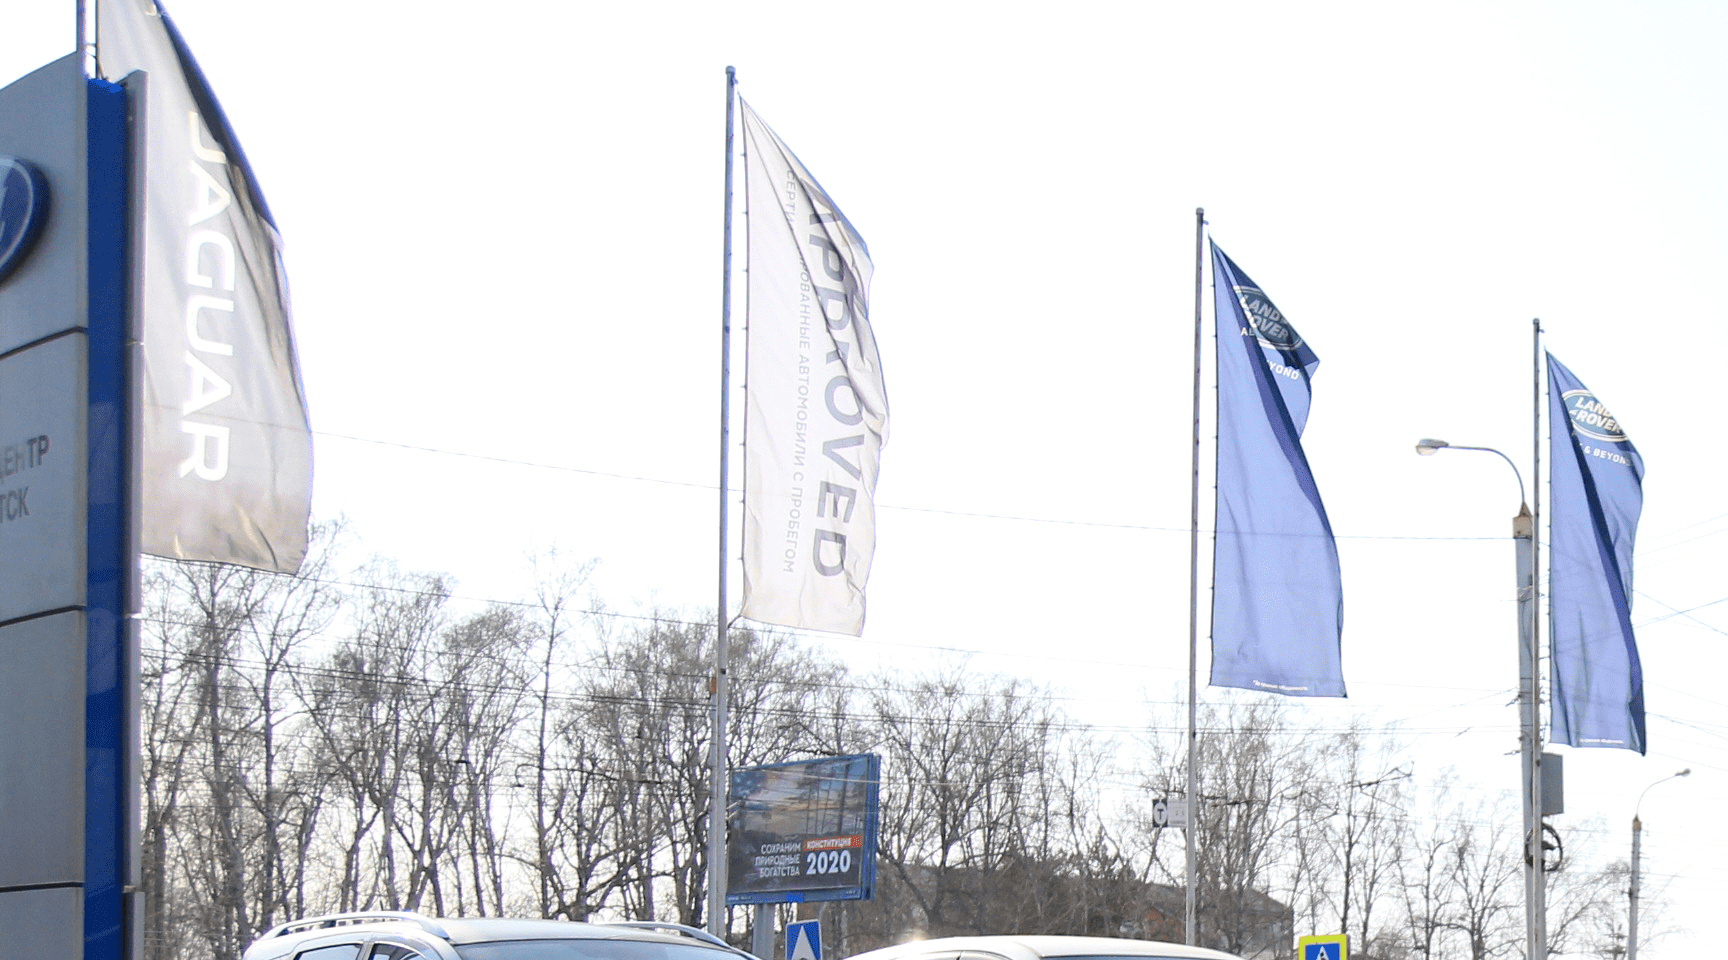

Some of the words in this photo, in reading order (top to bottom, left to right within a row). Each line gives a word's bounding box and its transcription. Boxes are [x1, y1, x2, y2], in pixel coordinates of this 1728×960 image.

[179, 110, 237, 482] JAGUAR
[1268, 360, 1300, 380] YOND
[792, 356, 811, 467] АВТОМОБИЛИ
[0, 434, 51, 480] ЕНТР
[793, 472, 804, 482] С
[783, 487, 804, 573] ПРОБЕГОМ
[761, 842, 801, 855] СОХРАНИМ
[755, 854, 801, 867] ПРИРОДНЫЕ
[759, 866, 801, 878] БОГАТСТВА
[806, 849, 851, 876] 2020
